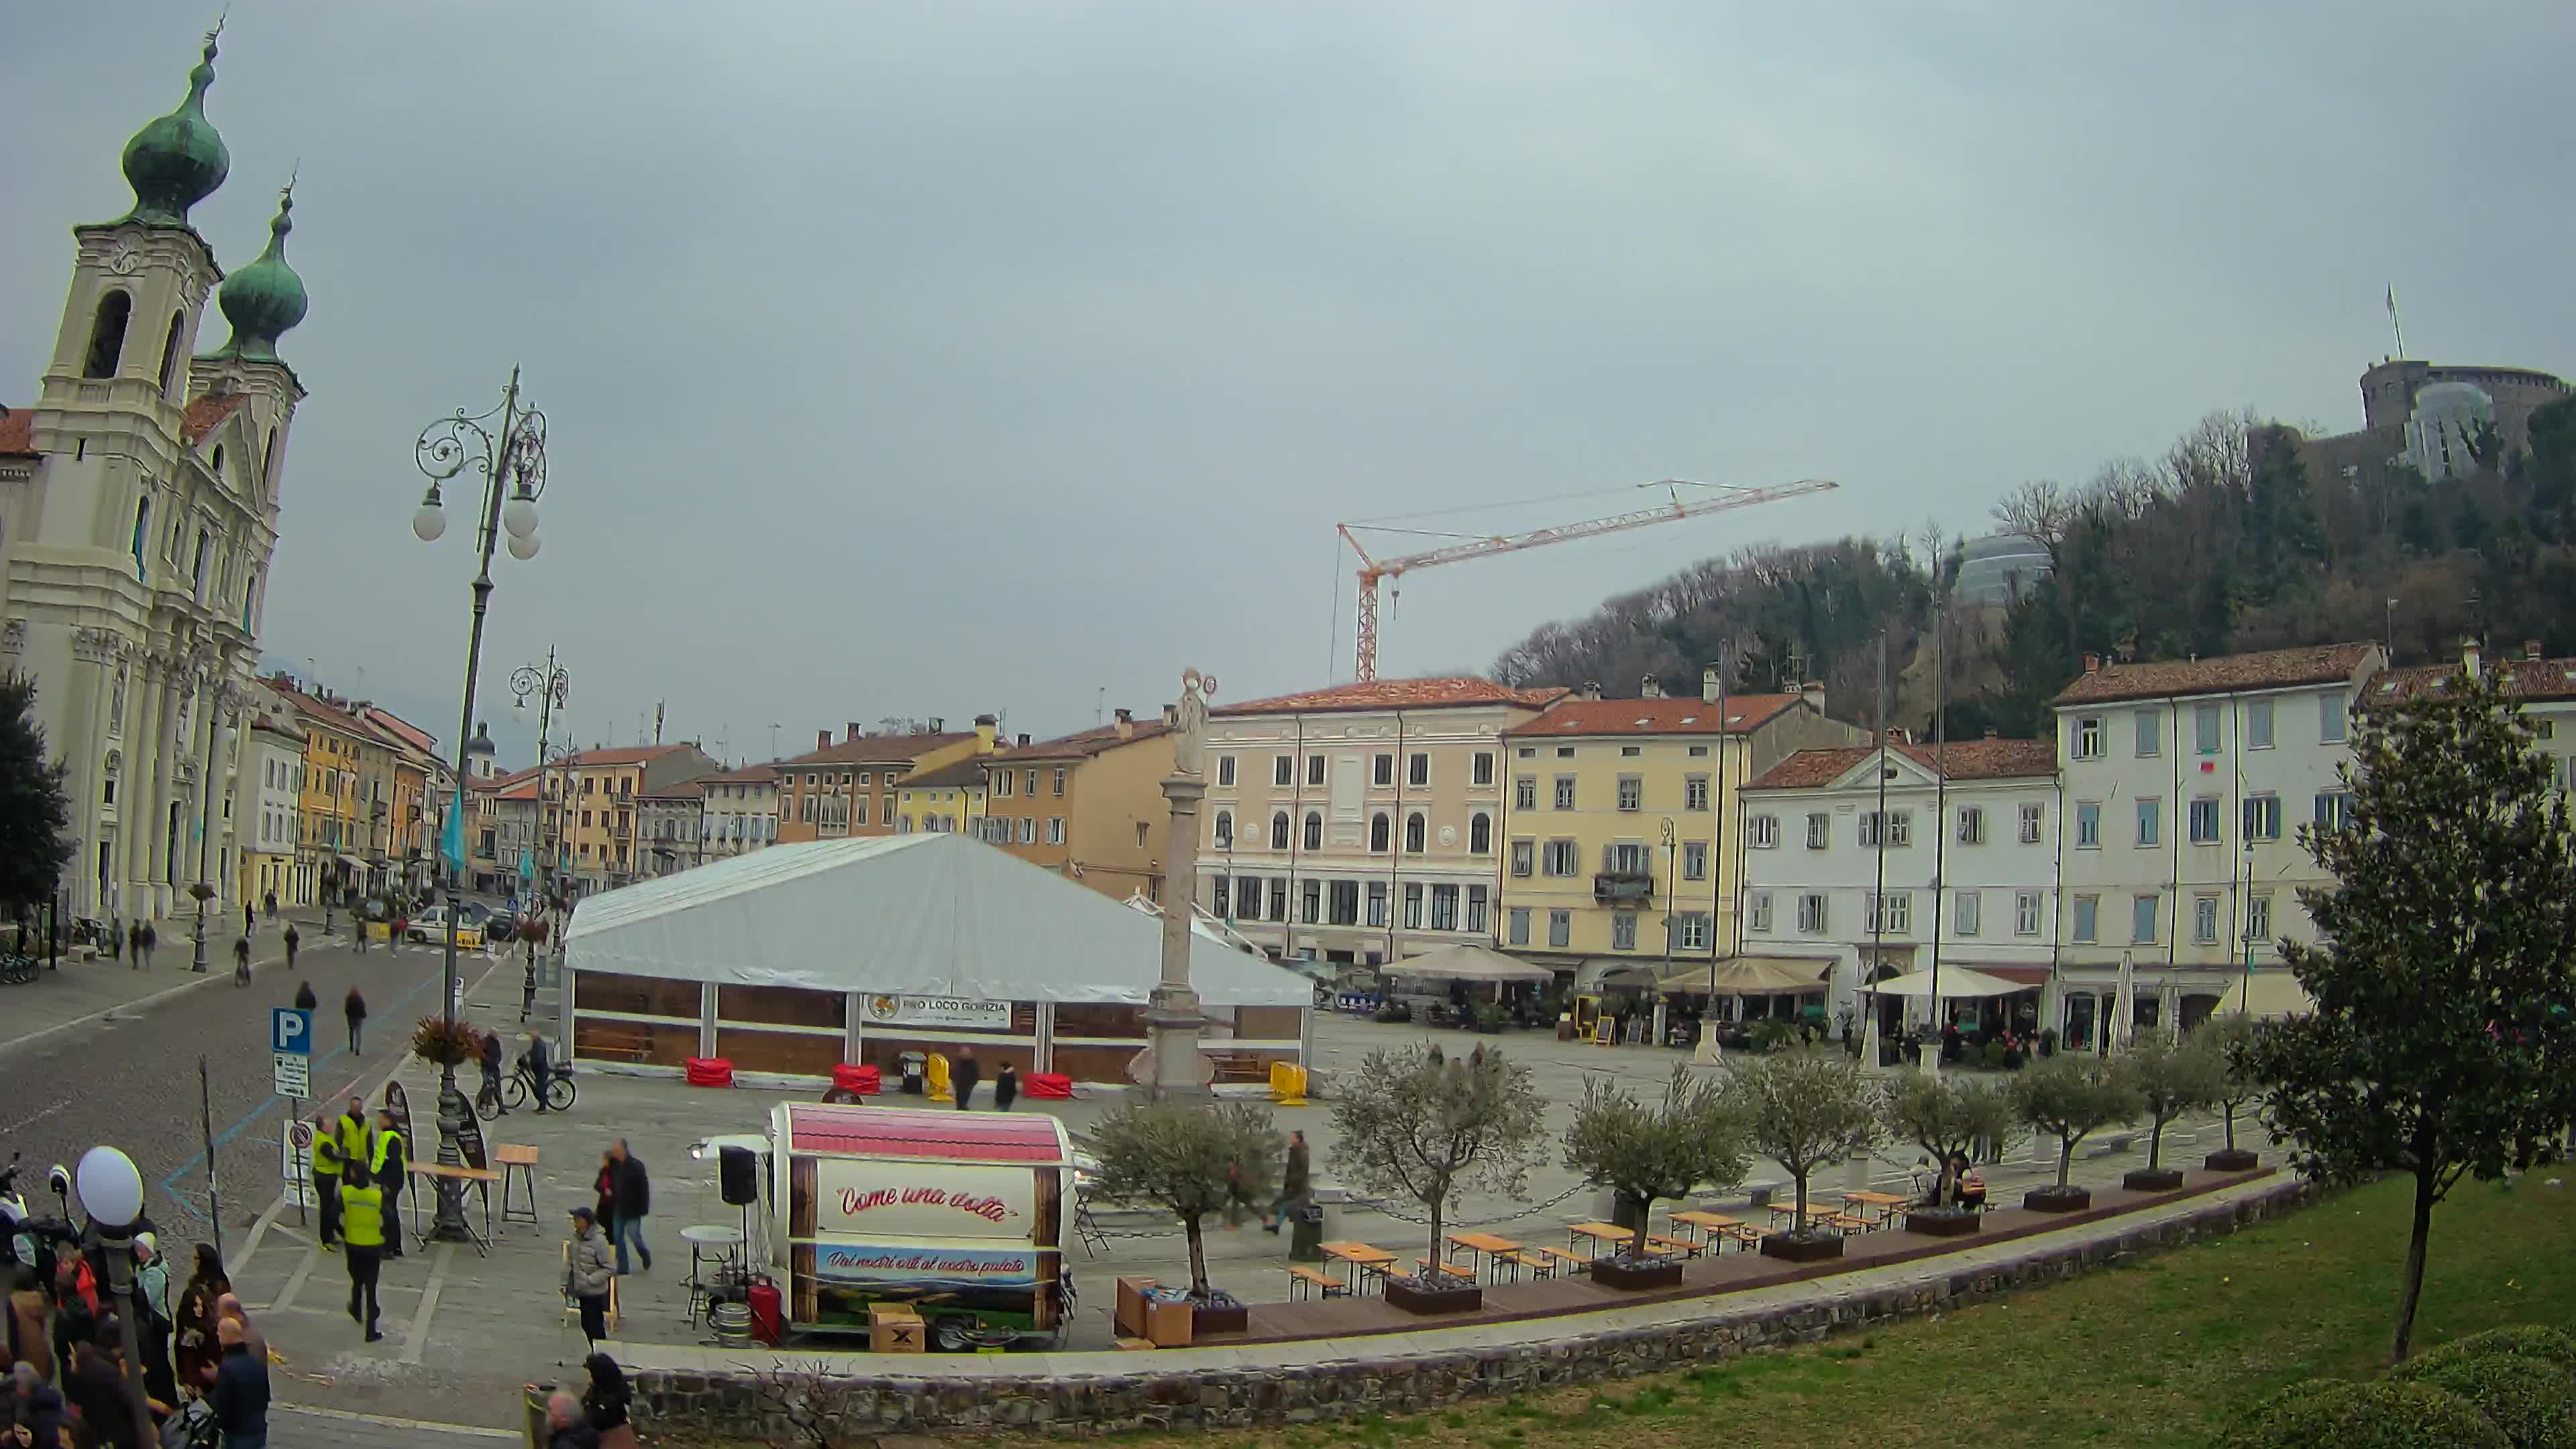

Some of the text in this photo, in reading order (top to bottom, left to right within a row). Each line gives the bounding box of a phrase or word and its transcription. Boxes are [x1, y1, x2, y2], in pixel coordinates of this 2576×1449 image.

[928, 1000, 959, 1010] LOCO
[961, 1002, 1006, 1012] GORIZIA
[279, 1012, 303, 1047] P
[901, 1186, 946, 1205] una
[827, 1251, 856, 1267] Dai
[920, 1256, 939, 1271] al
